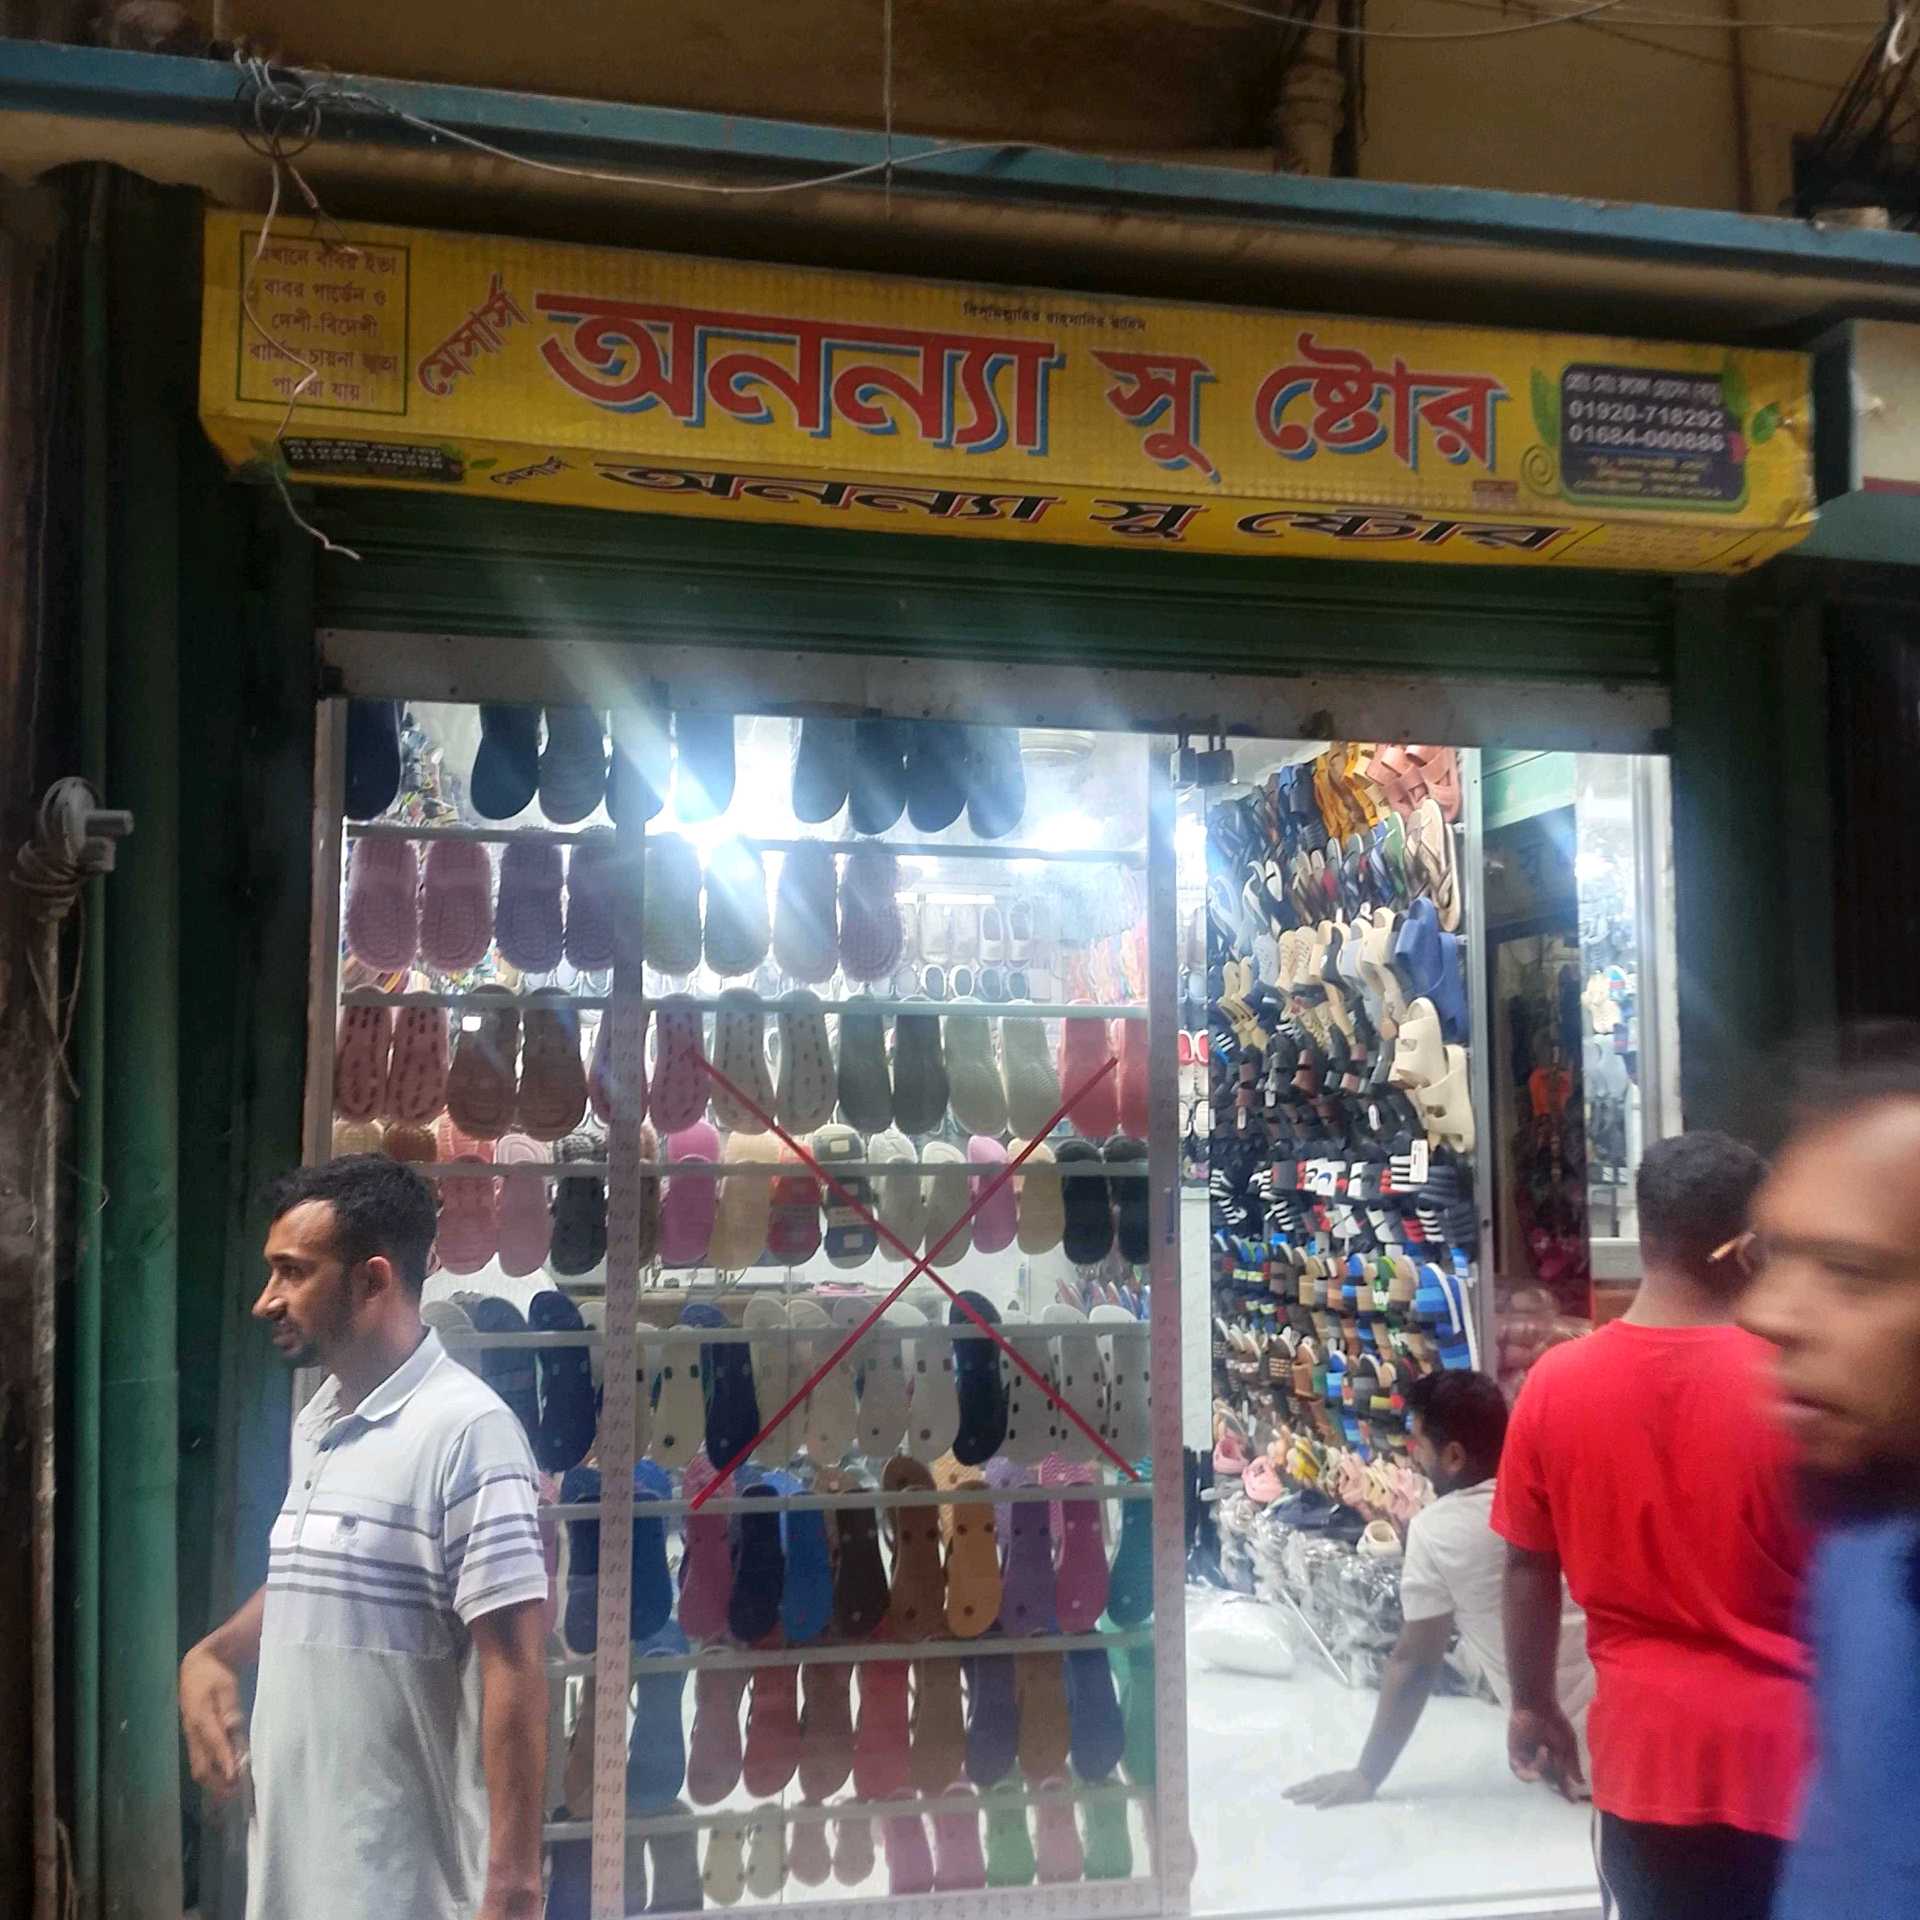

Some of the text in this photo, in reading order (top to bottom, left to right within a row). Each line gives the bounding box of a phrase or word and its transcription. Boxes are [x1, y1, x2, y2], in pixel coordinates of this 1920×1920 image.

[417, 273, 528, 396] মেসার্স
[534, 288, 1067, 457] অনন্যা
[1089, 349, 1222, 485] সু
[592, 462, 1066, 524] অনন্যা
[1088, 499, 1210, 542] সু
